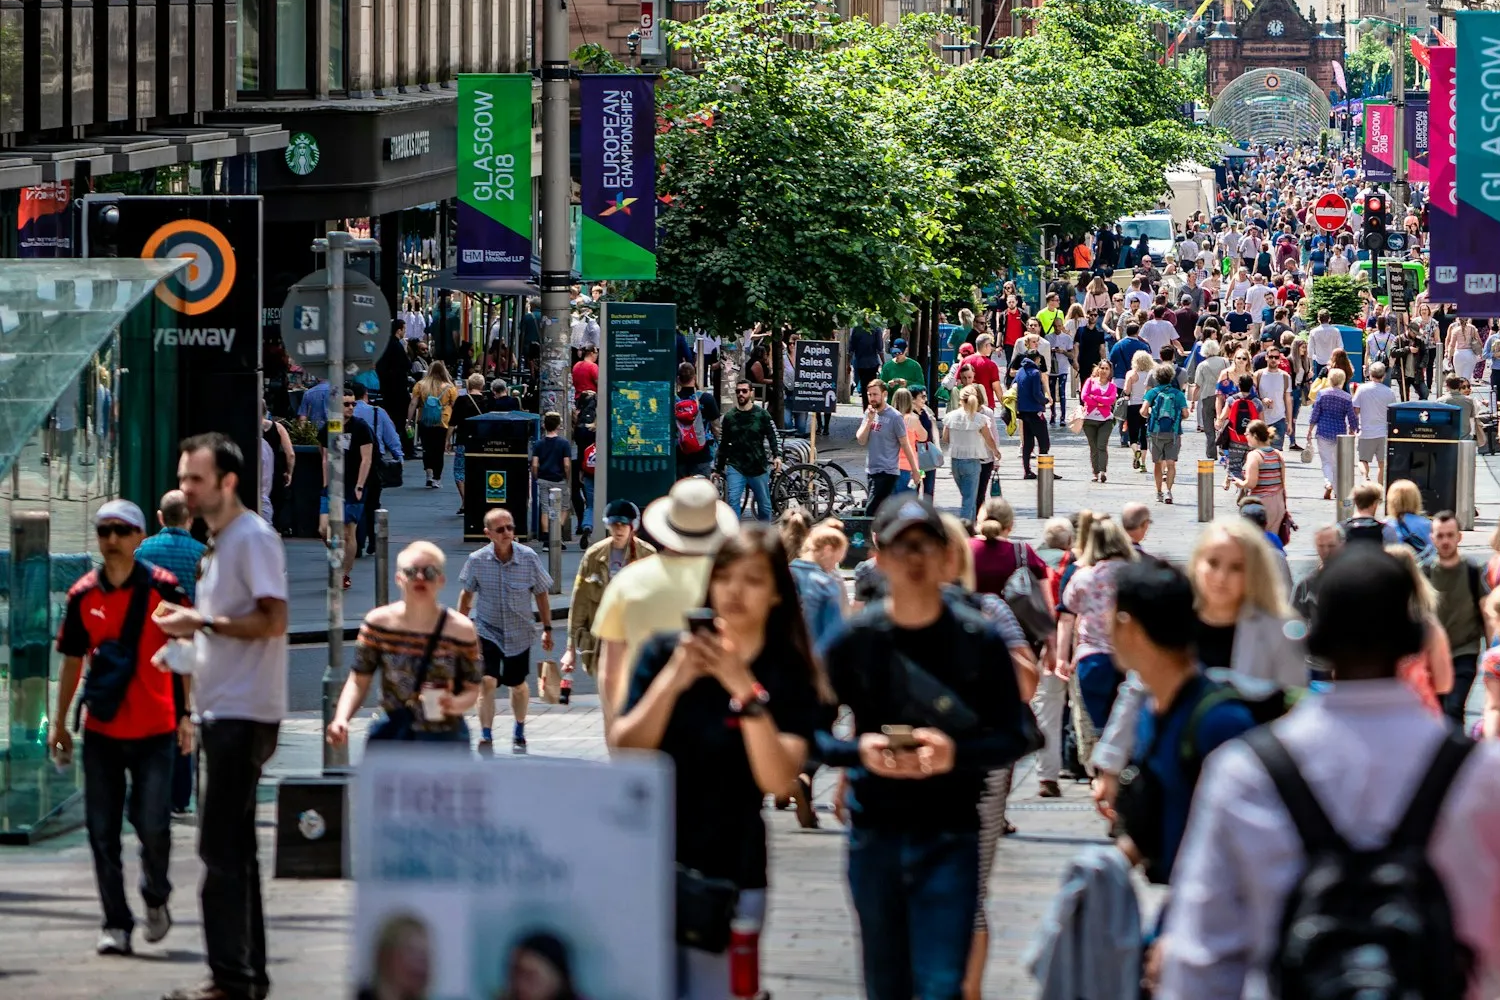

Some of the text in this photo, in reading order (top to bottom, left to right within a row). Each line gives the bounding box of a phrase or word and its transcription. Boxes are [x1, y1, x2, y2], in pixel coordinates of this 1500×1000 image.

[603, 90, 621, 189] EUROPEAN
[621, 90, 634, 189] CHAMPIONSHIPS
[1372, 111, 1381, 153] GLASGOW
[474, 90, 494, 201] GLASGOW
[1380, 135, 1389, 153] 2018
[495, 153, 515, 201] 2018
[464, 250, 482, 262] HM
[485, 249, 506, 257] Harper
[1467, 275, 1495, 291] HM
[804, 346, 830, 356] Apple
[800, 358, 832, 367] Sales &
[799, 370, 832, 380] Repairs
